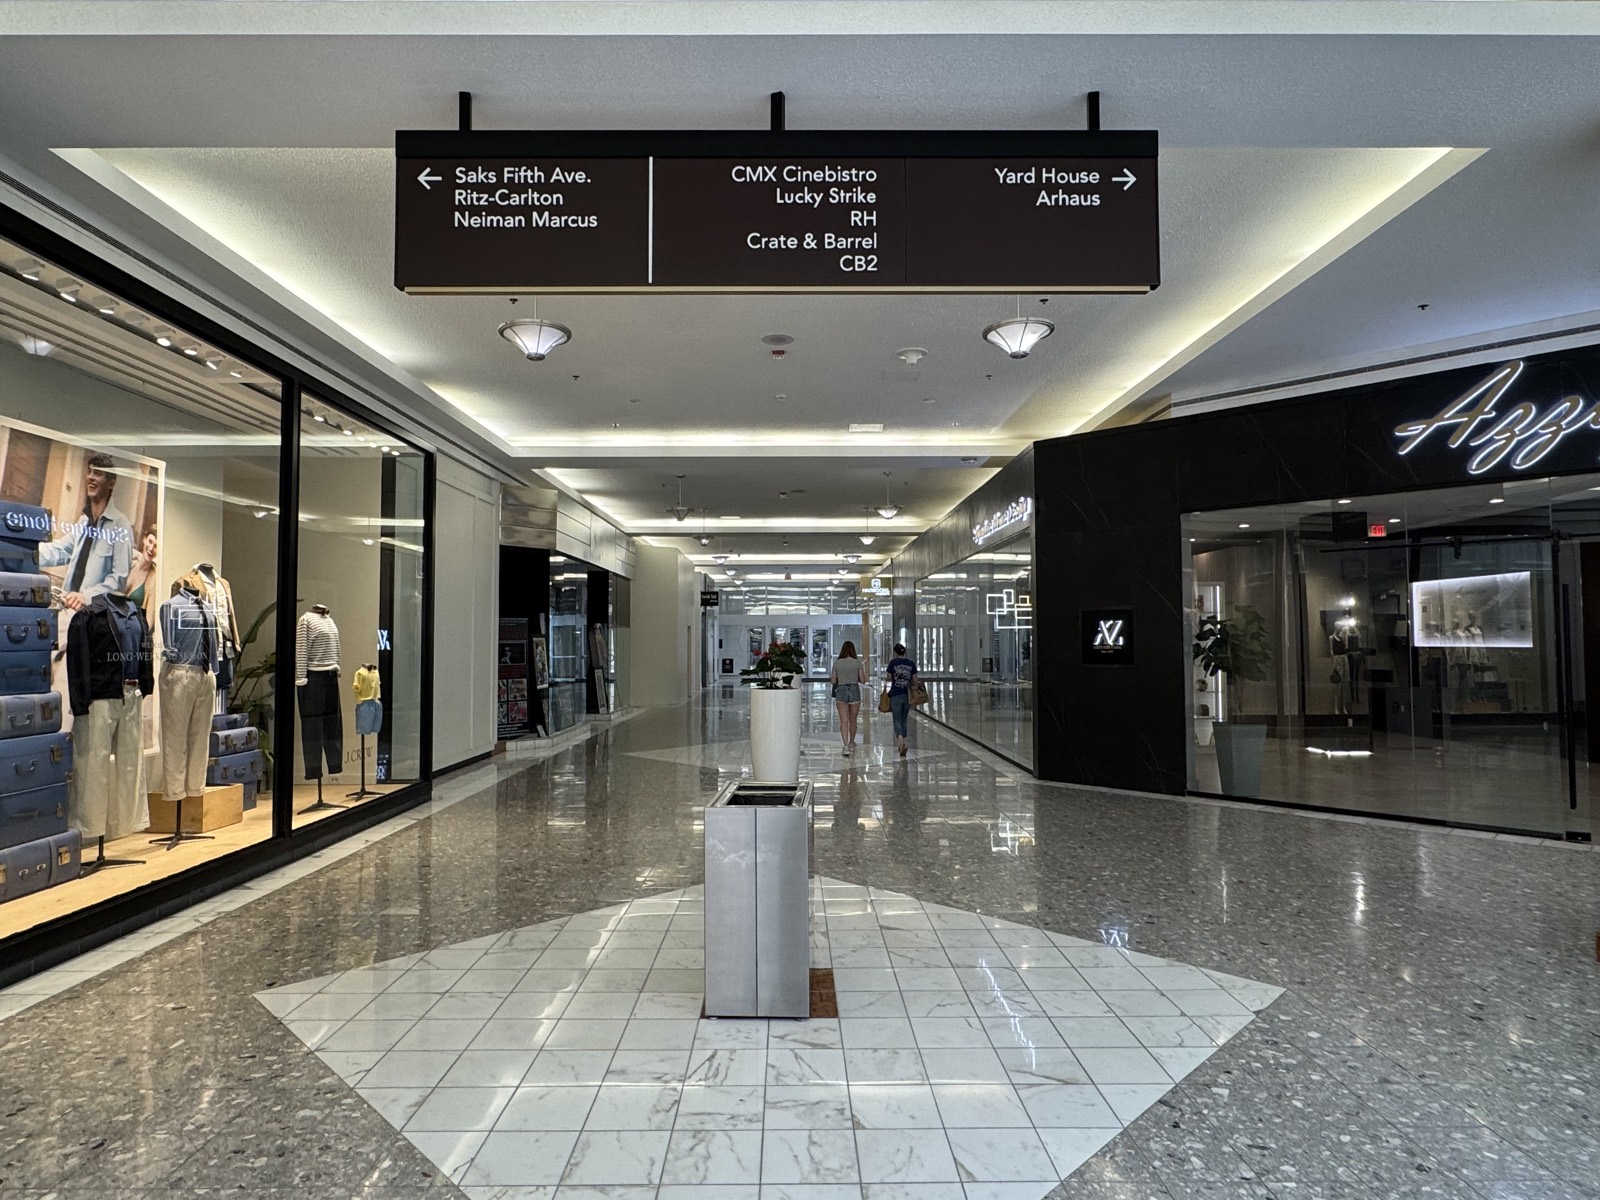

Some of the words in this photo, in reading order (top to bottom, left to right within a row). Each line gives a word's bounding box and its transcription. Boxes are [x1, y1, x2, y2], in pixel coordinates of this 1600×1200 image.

[455, 166, 497, 183] Saks
[503, 166, 545, 183] Fifth
[550, 167, 592, 183] Ave.
[731, 165, 778, 182] CMX
[782, 165, 878, 182] Cinebistro
[994, 167, 1036, 184] Yard
[1042, 167, 1100, 184] House
[454, 188, 564, 205] Ritz-Carlton
[776, 186, 824, 208] Lucky
[828, 186, 877, 203] Strike
[1035, 189, 1101, 207] Arhaus
[454, 211, 526, 227] Neiman
[532, 211, 598, 227] Marcus
[850, 210, 877, 226] RH
[746, 232, 799, 249] Crate
[802, 233, 818, 249] &
[824, 232, 878, 249] Barrel
[839, 255, 878, 271] CB2
